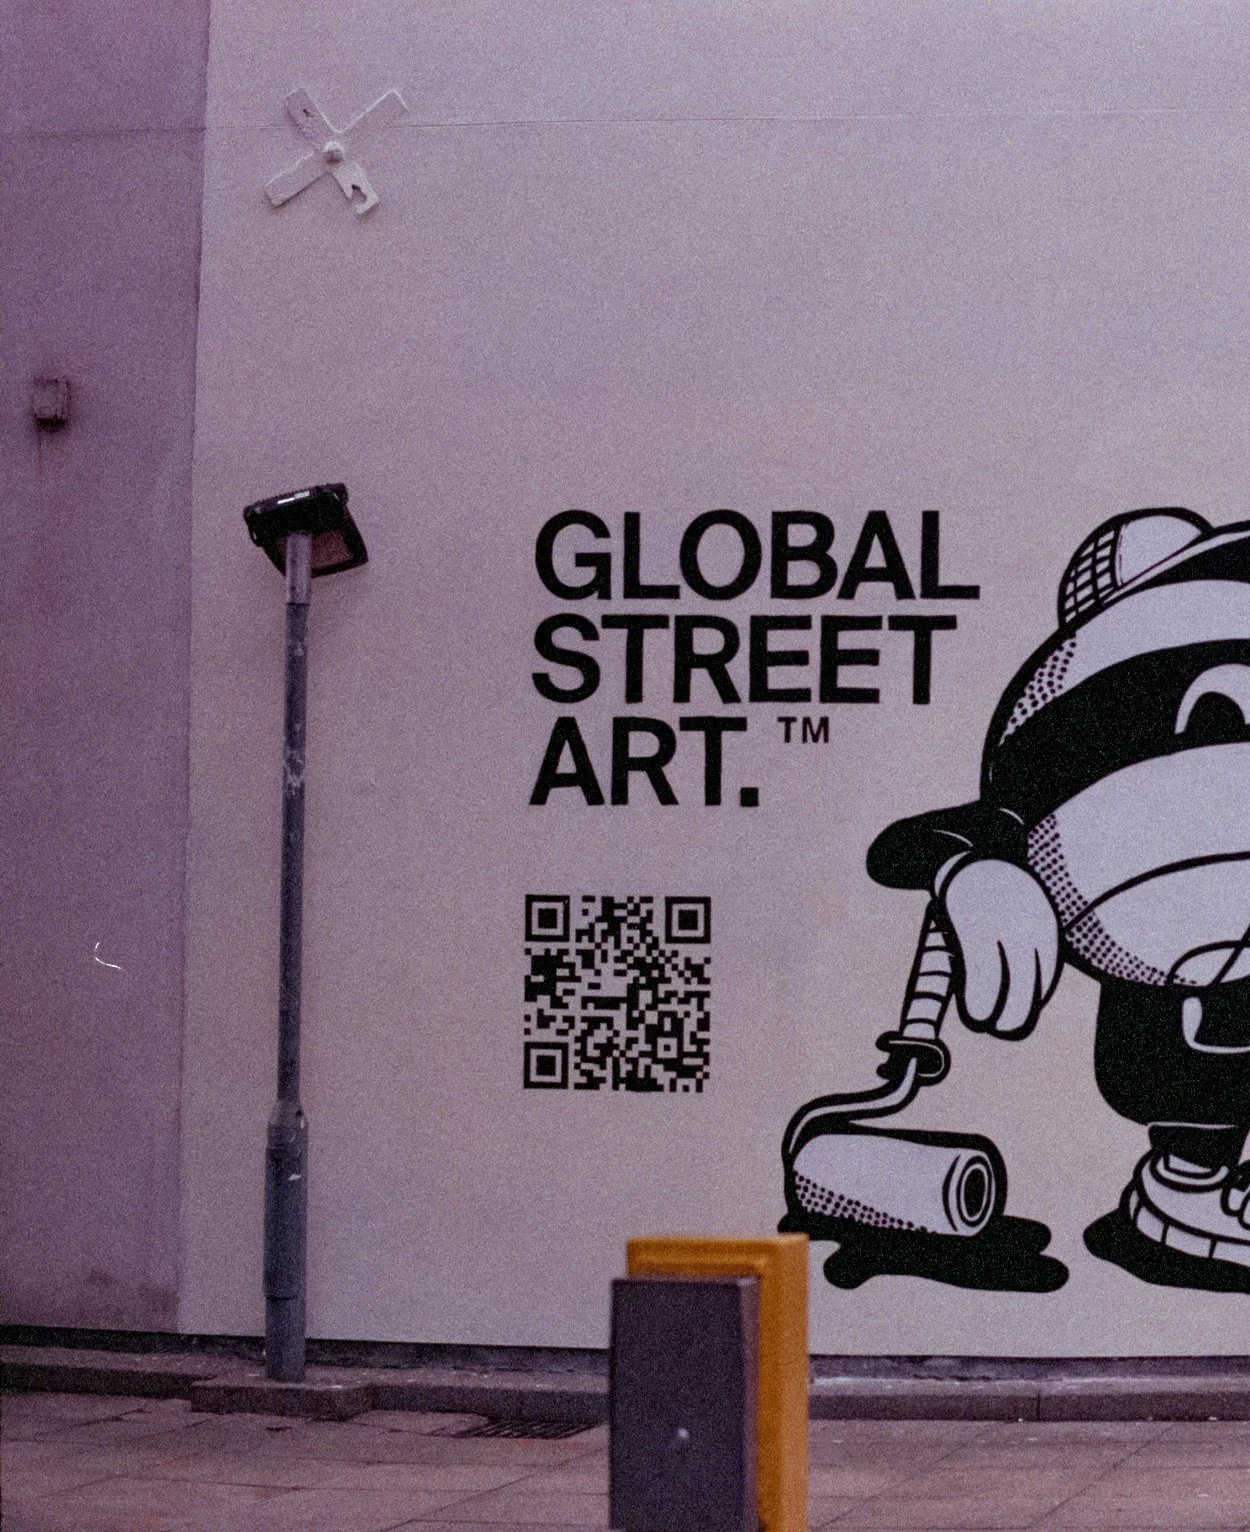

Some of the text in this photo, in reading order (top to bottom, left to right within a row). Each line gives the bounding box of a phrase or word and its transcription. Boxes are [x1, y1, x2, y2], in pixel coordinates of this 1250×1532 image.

[534, 508, 981, 602] GLOBAL
[531, 612, 958, 706] STREET
[528, 715, 760, 808] ART.
